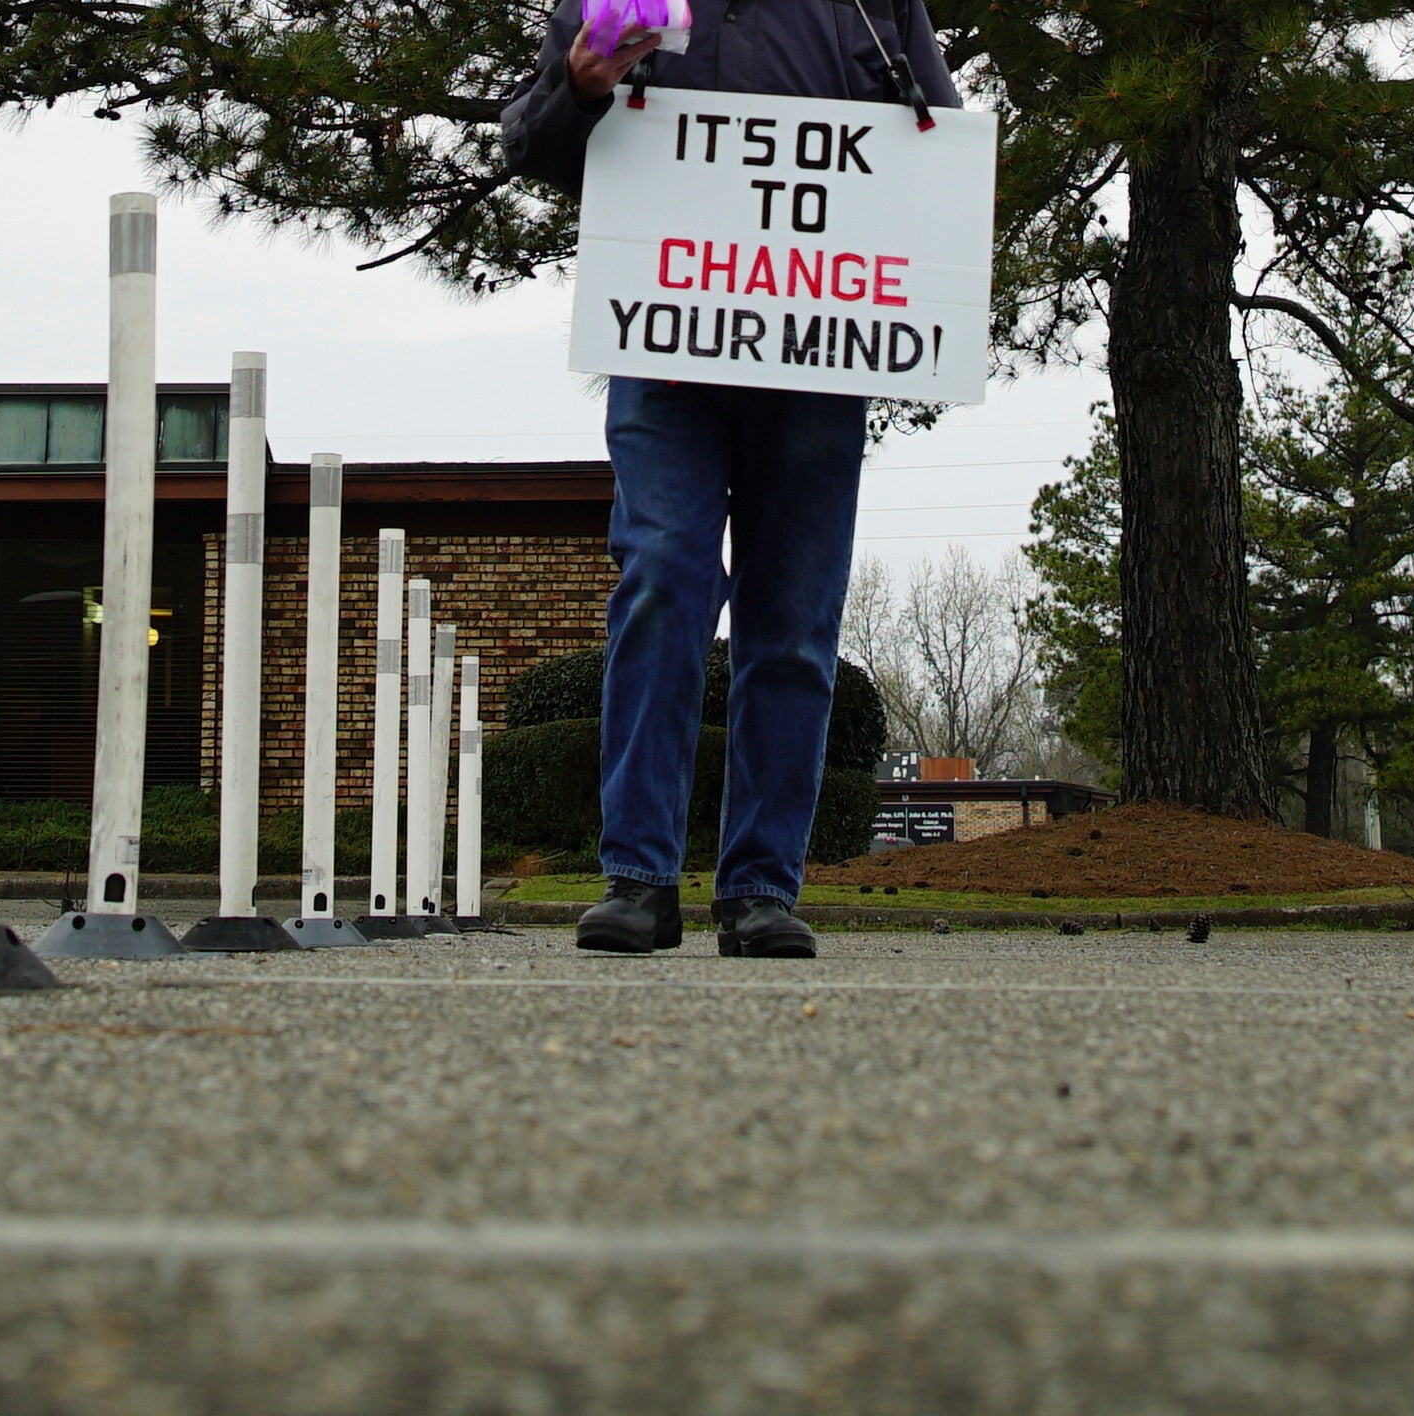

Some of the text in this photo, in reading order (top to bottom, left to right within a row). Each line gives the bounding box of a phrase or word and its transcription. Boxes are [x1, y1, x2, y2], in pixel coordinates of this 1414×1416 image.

[675, 113, 873, 175] IT'S OK
[750, 179, 827, 233] TO
[658, 237, 909, 307] CHANGE
[609, 298, 943, 376] YOUR MIND!
